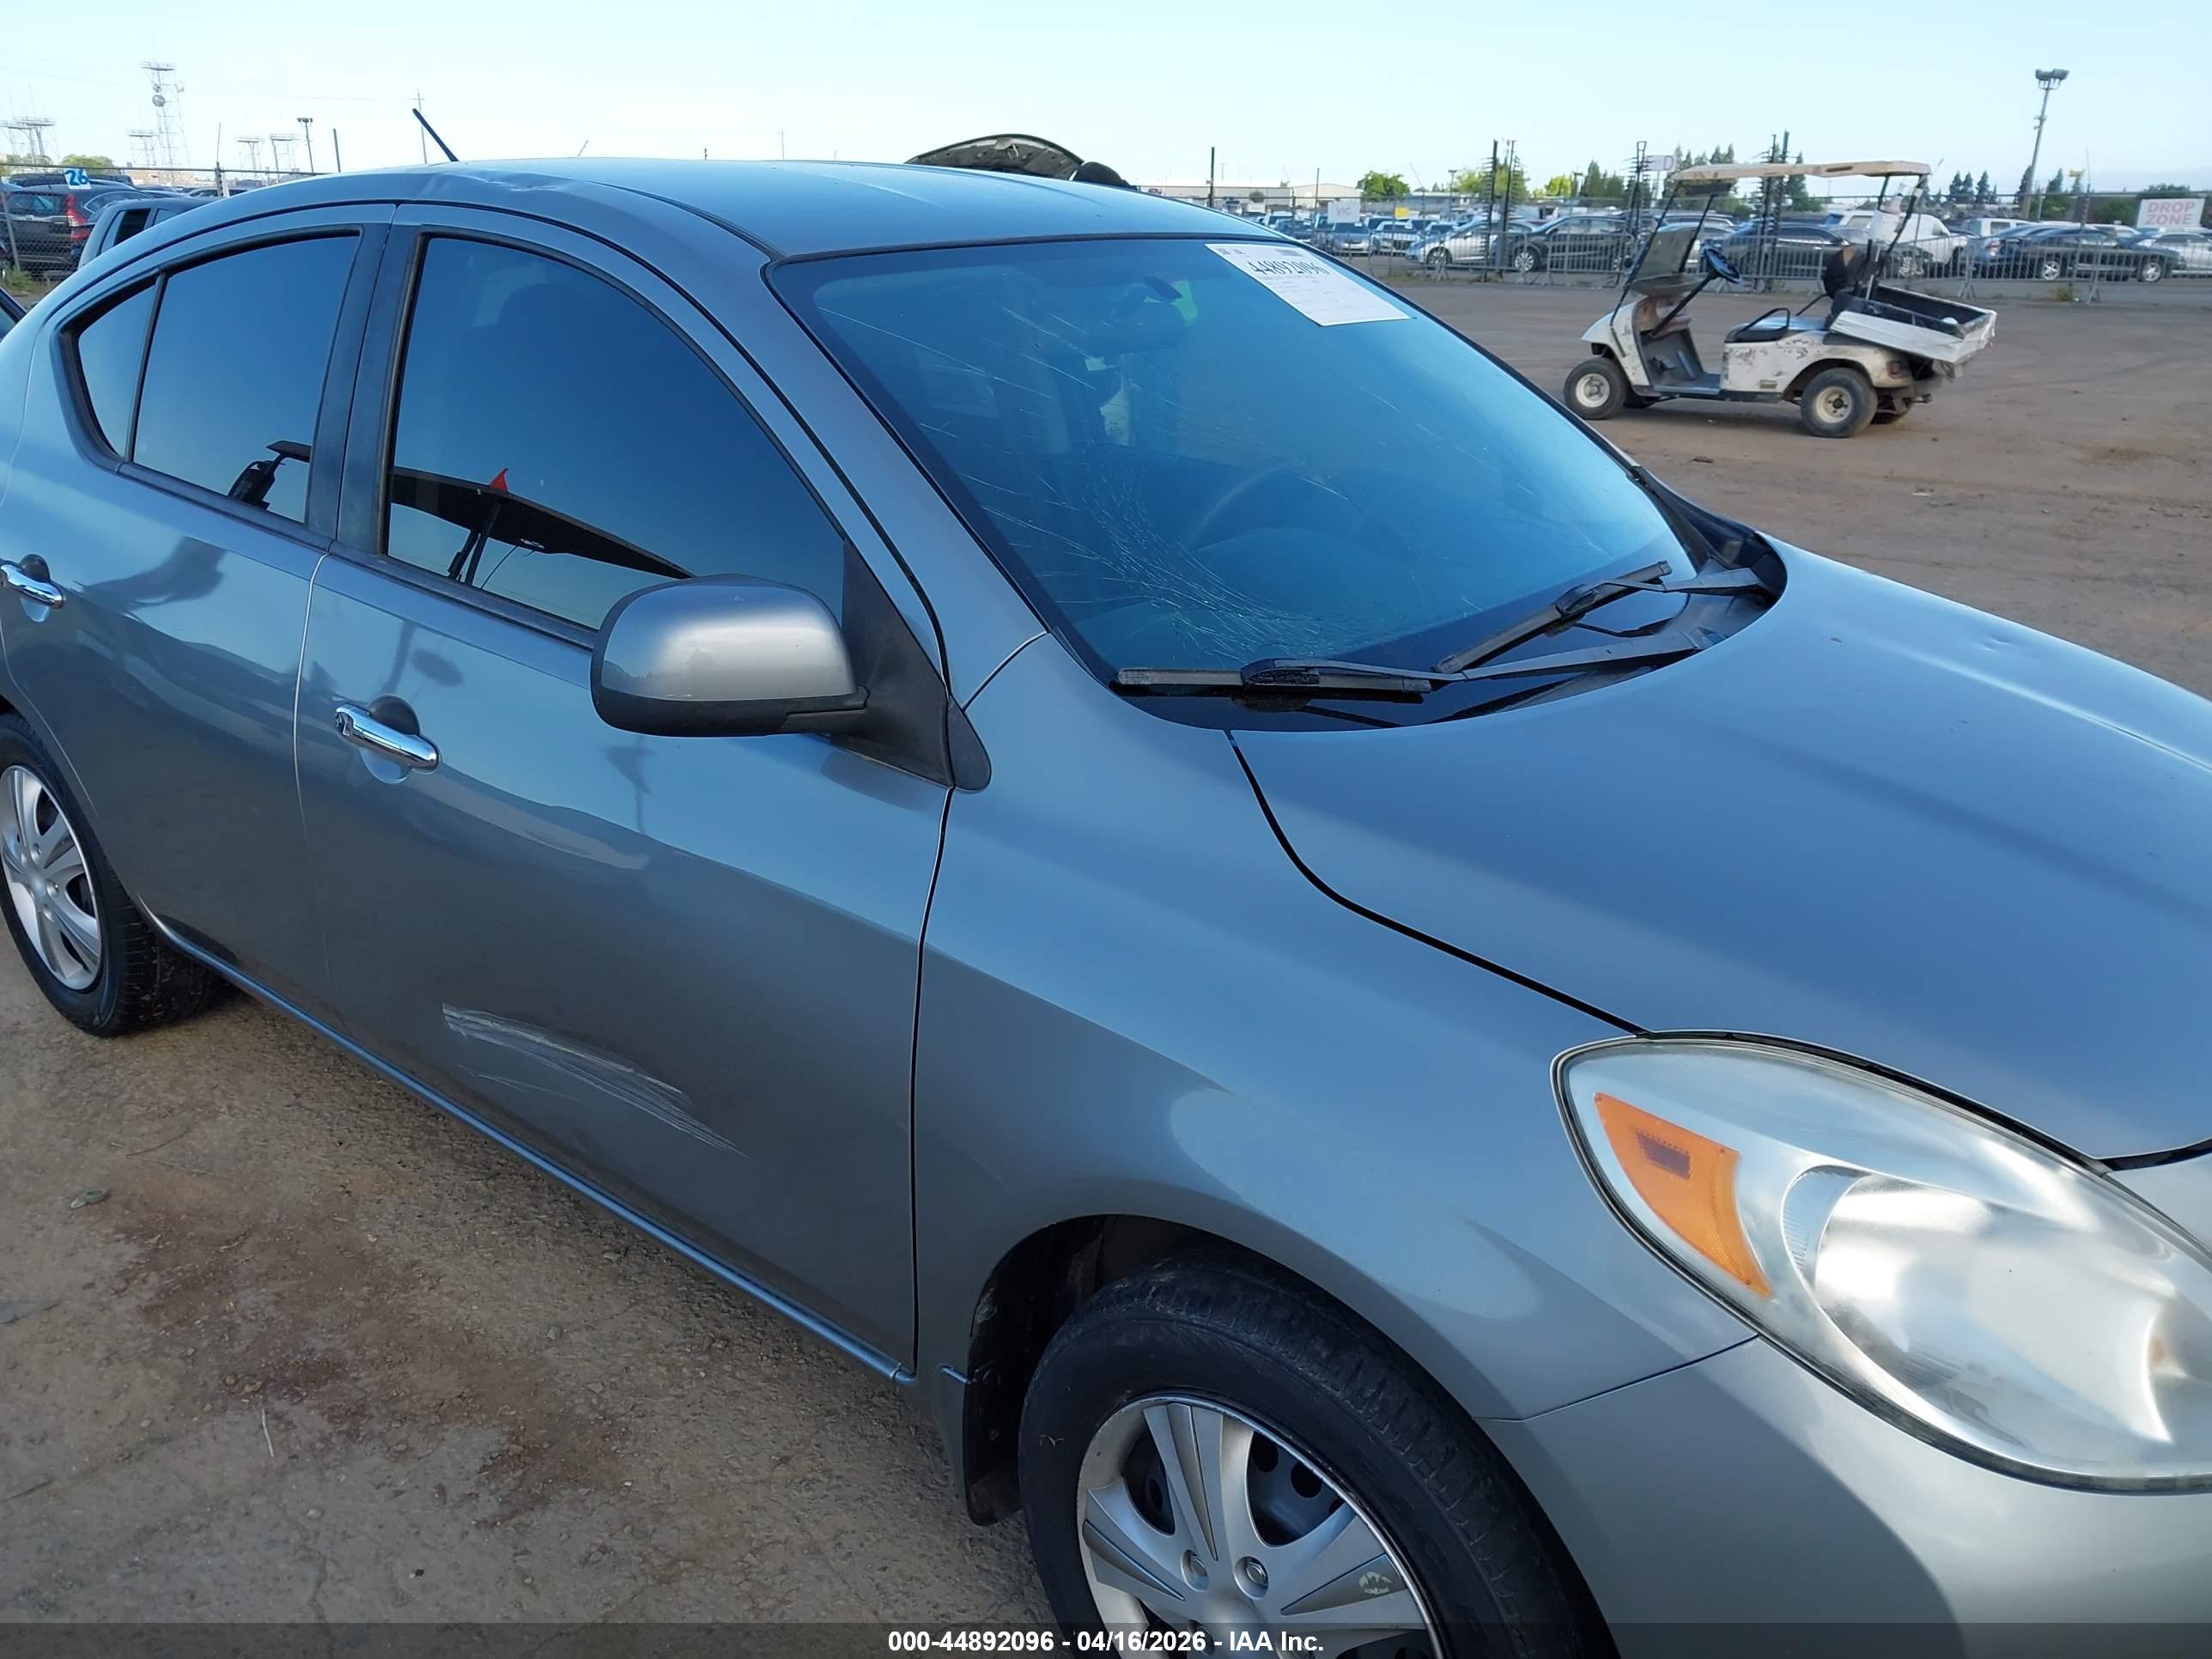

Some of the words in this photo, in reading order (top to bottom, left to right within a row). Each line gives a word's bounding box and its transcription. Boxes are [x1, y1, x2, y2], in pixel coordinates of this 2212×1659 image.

[64, 167, 88, 186] 26
[2148, 201, 2196, 213] DROP
[2144, 213, 2194, 225] ZONE
[1246, 260, 1330, 275] 44892096
